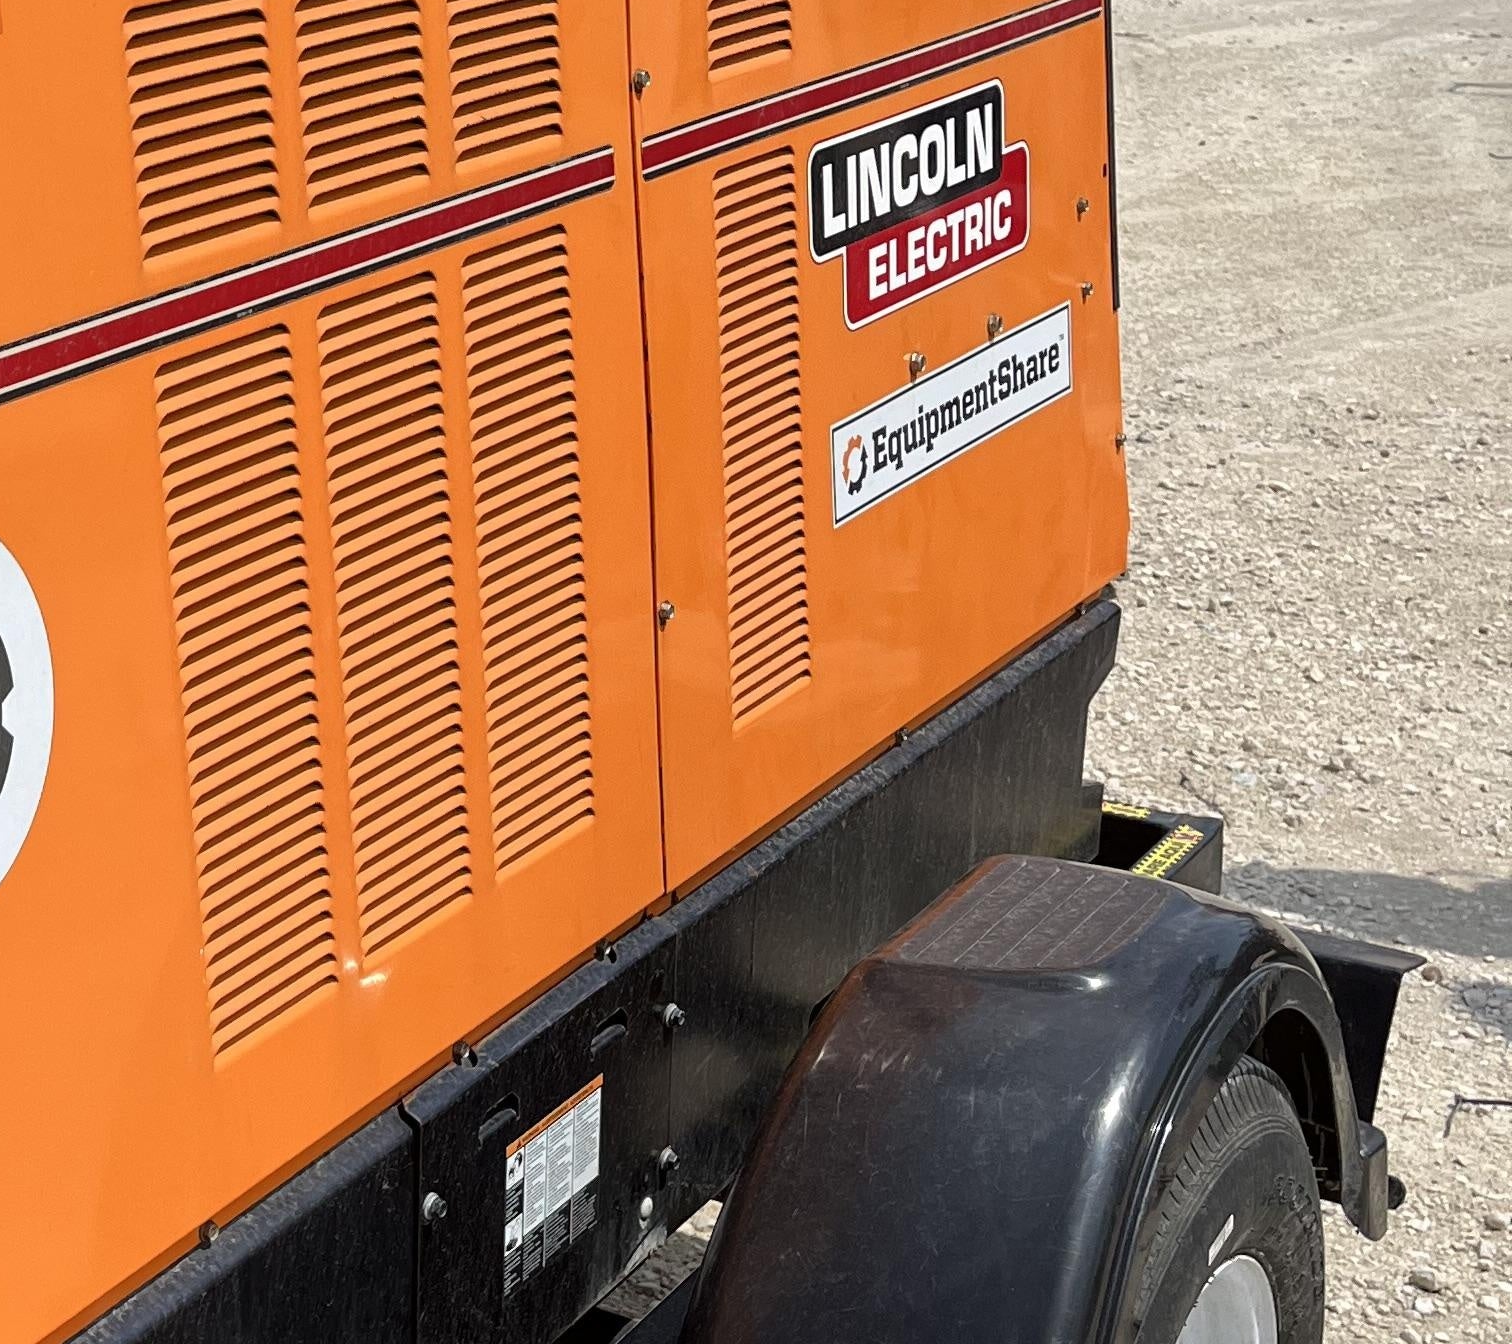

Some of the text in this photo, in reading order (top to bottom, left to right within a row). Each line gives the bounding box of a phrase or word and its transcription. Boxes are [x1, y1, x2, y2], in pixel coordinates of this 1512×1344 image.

[822, 102, 994, 239] LINCOLN
[868, 188, 1012, 301] ELECTRIC
[872, 341, 1061, 474] EquipmentShare
